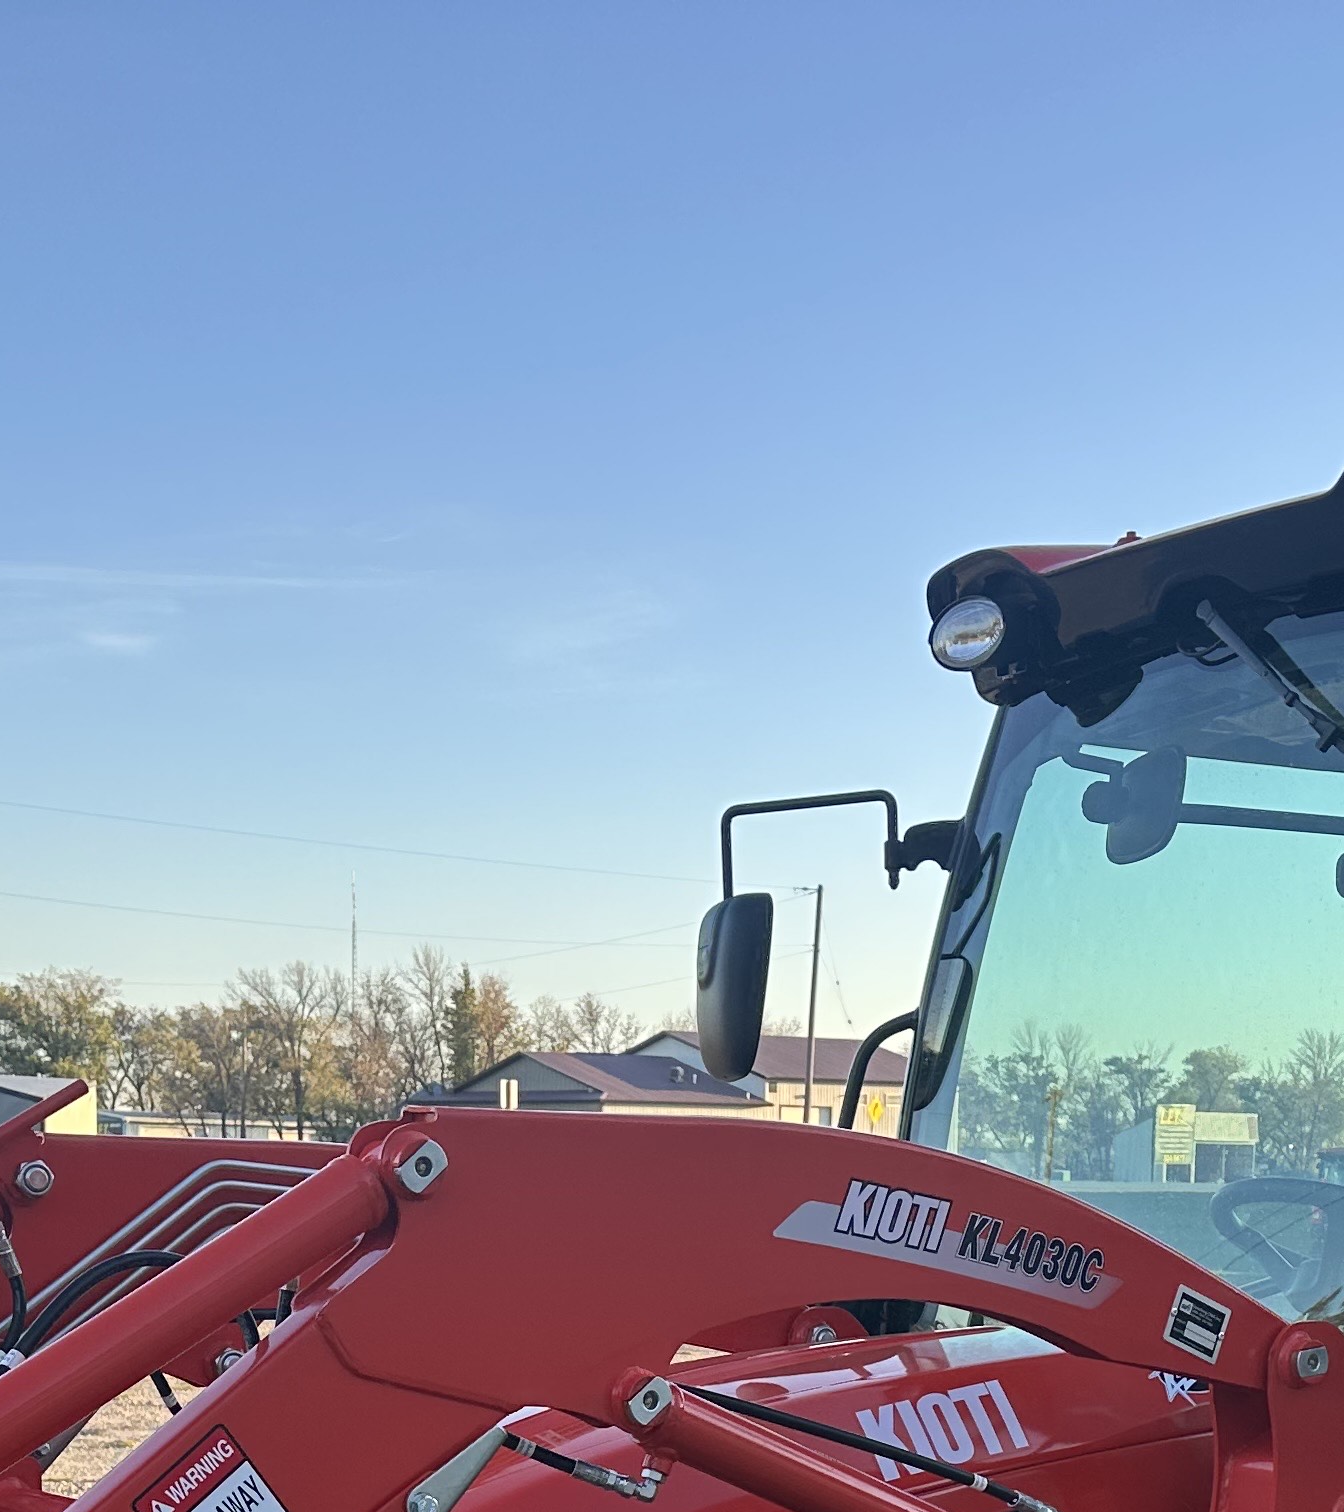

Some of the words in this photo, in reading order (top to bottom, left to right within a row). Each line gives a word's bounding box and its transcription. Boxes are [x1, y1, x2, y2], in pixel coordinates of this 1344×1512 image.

[834, 1179, 951, 1253] KIOTI
[956, 1212, 1105, 1293] KL4030C
[164, 1439, 235, 1504] WARNING
[856, 1379, 1029, 1482] KIOTI
